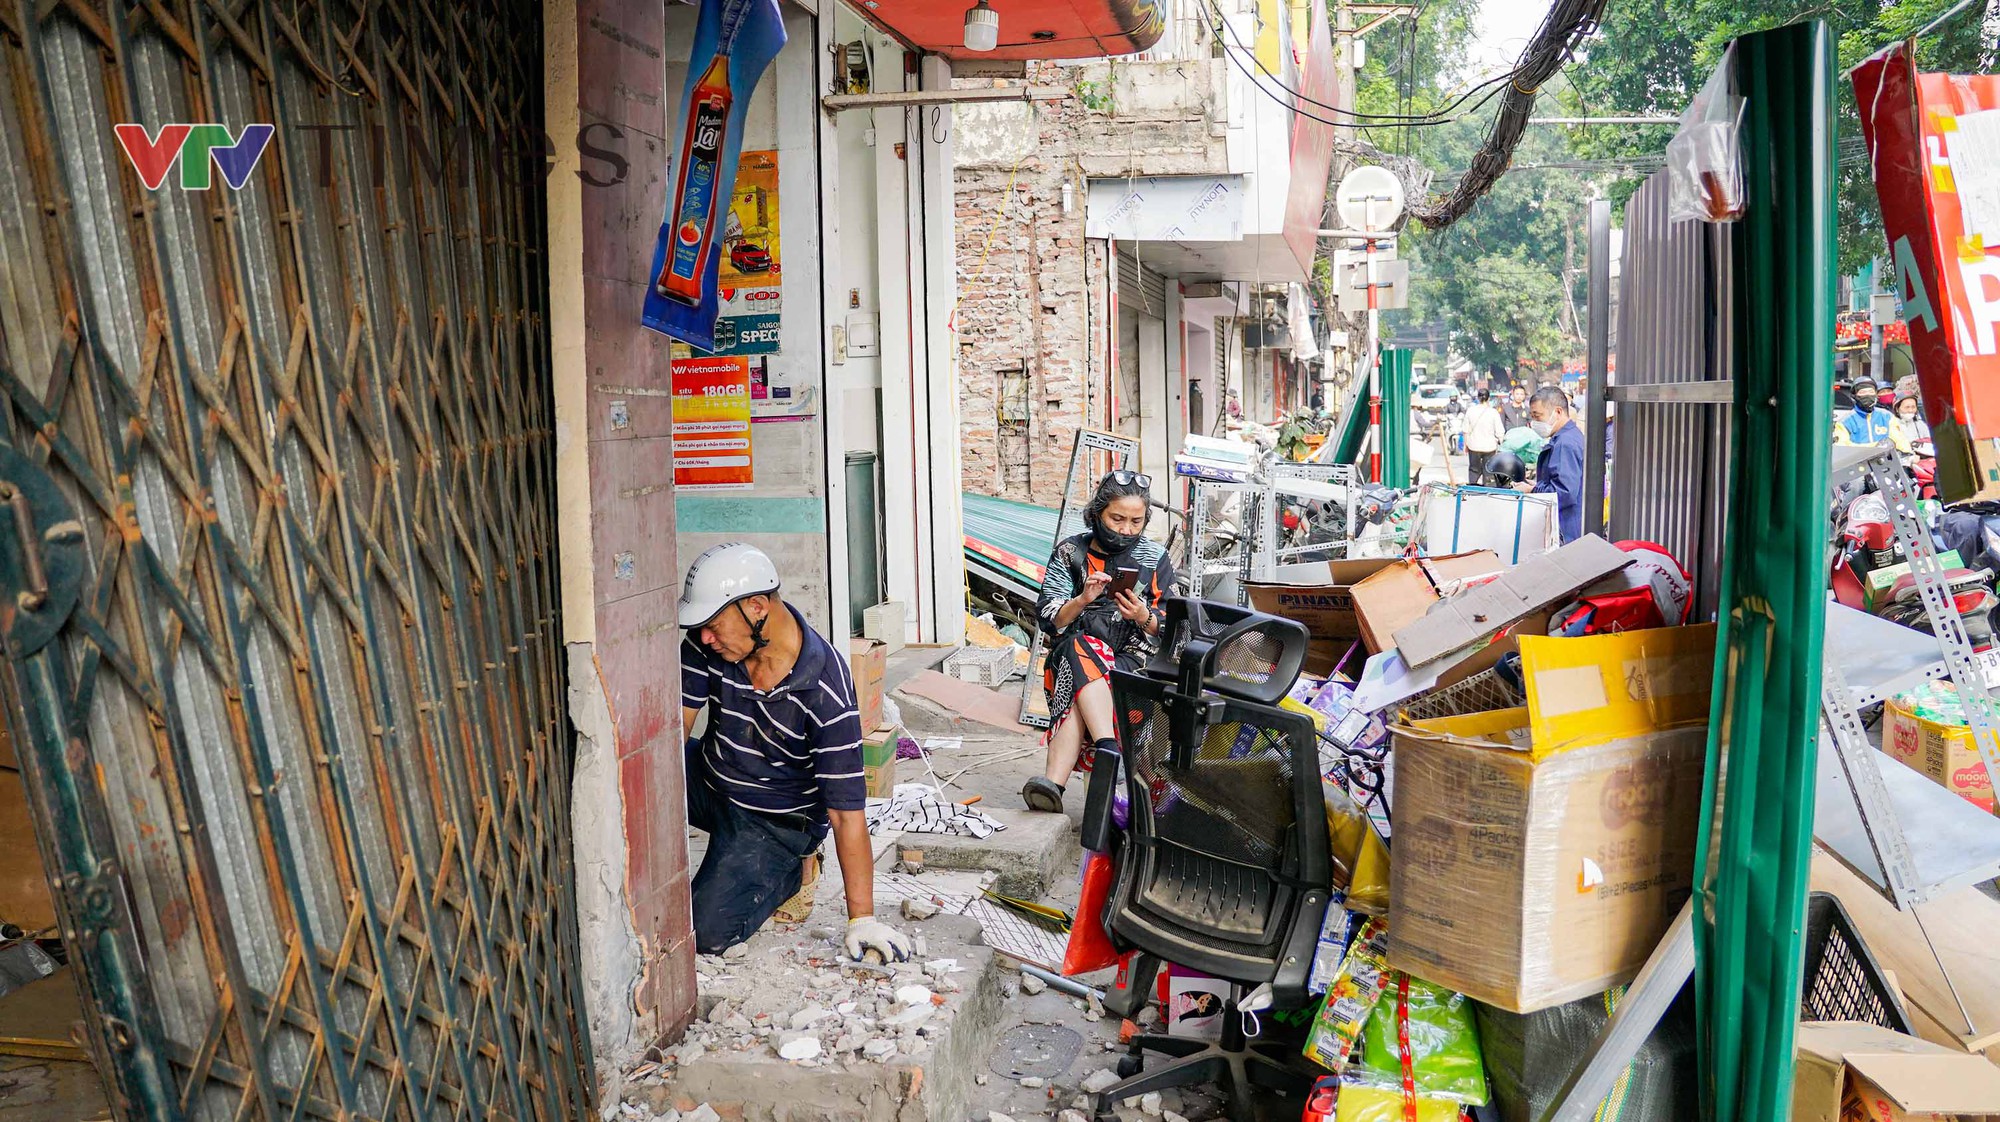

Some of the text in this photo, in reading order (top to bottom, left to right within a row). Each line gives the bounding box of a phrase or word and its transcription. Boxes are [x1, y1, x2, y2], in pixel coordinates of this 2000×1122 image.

[1105, 193, 1144, 227] LIONALU
[1190, 183, 1229, 220] LIONALU
[687, 364, 740, 374] vietnamobile
[702, 384, 745, 398] 180GB
[1470, 826, 1521, 846] 4Packs
